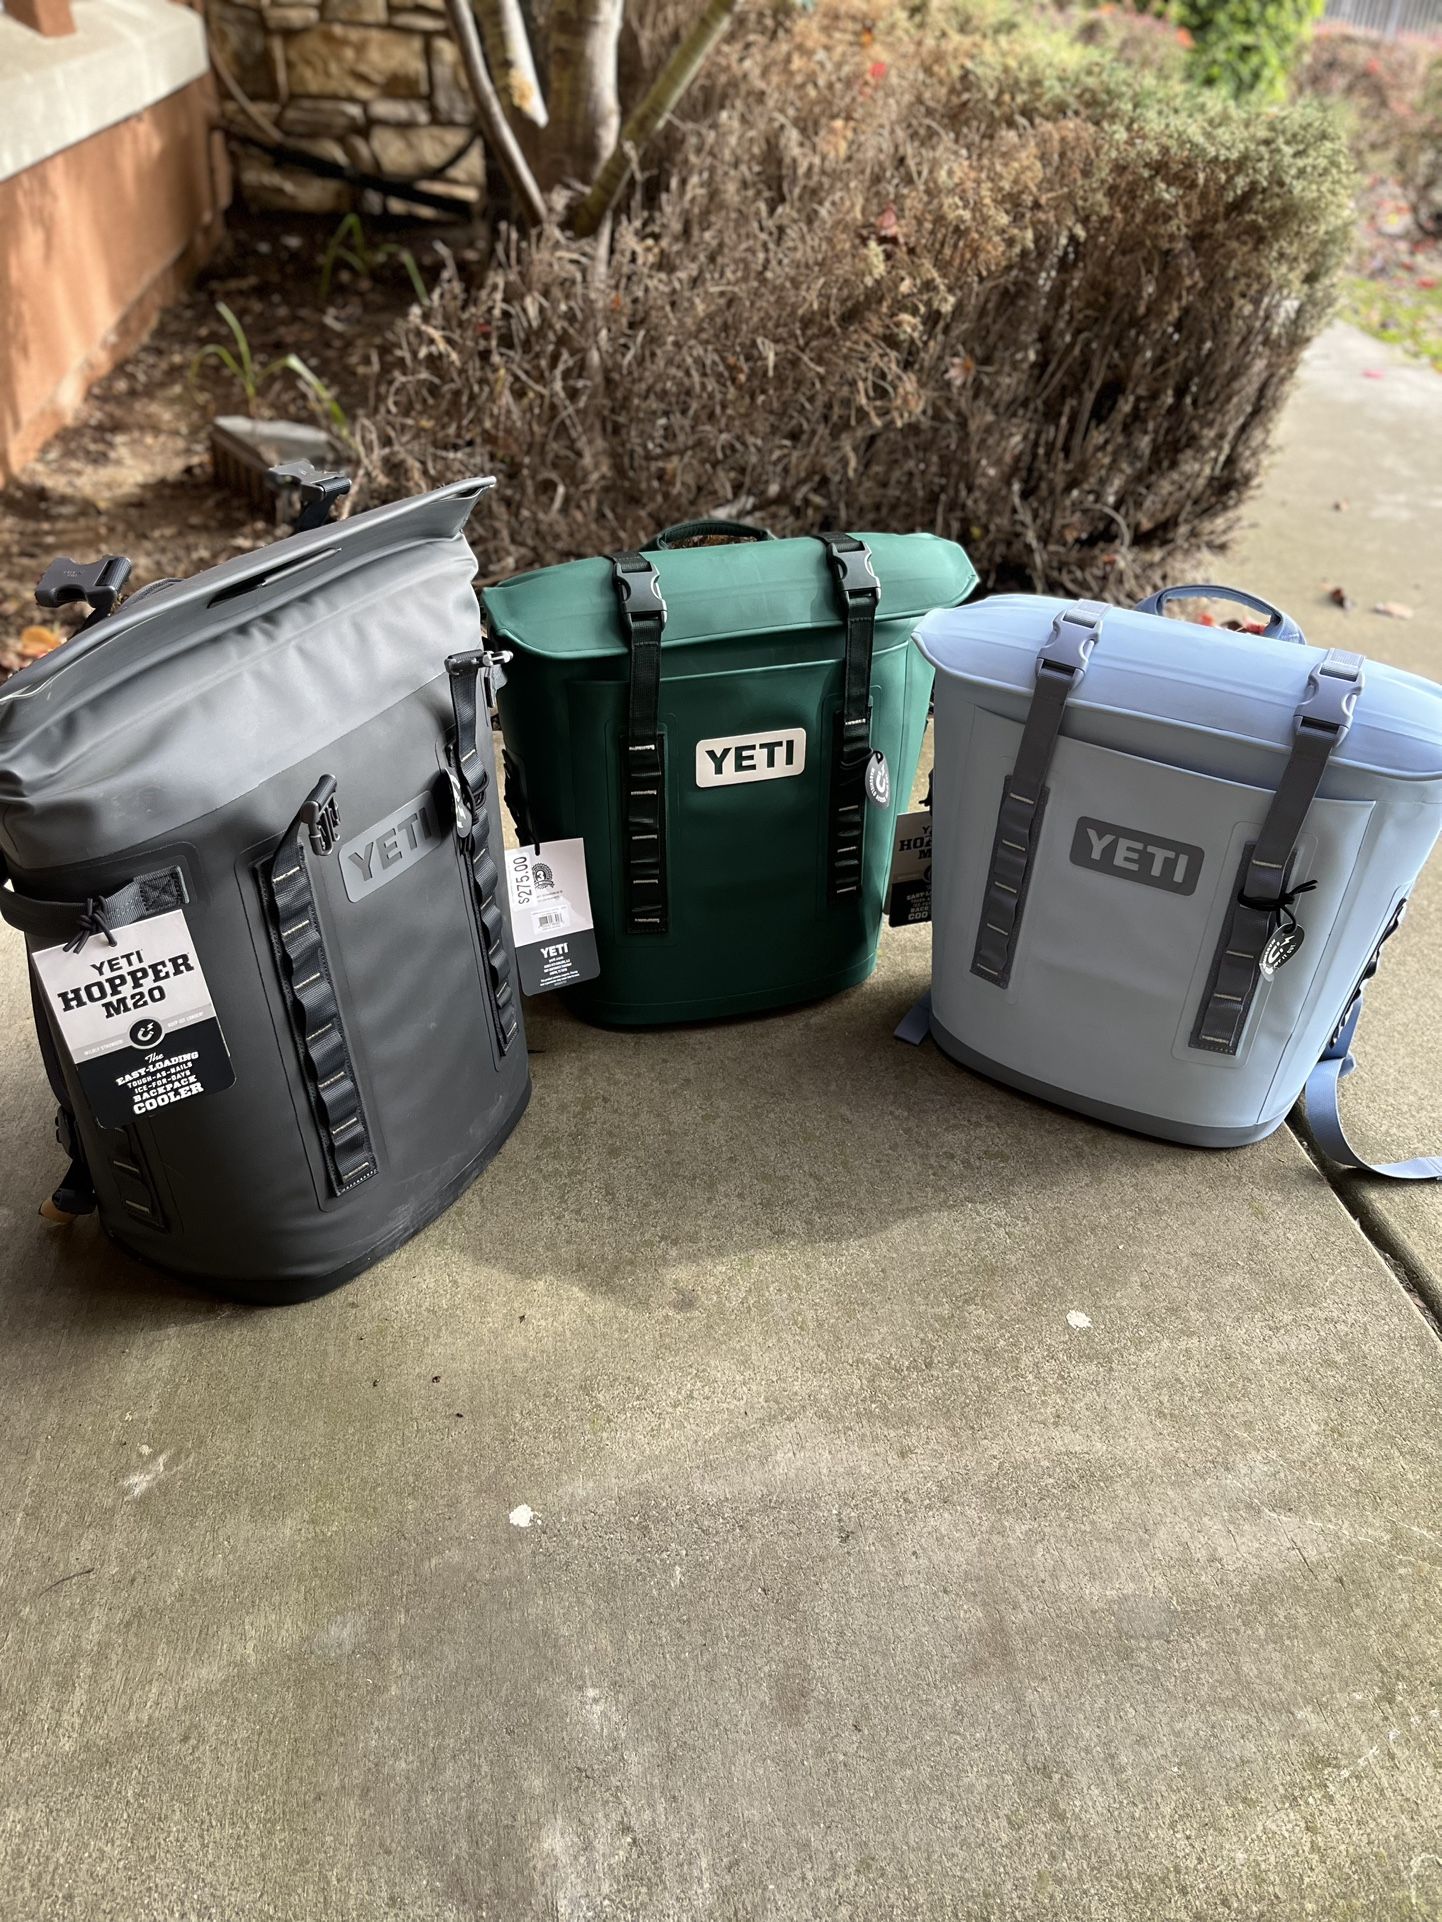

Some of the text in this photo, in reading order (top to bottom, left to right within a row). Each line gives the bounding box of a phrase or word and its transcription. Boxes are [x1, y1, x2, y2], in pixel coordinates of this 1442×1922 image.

[705, 740, 794, 775] YETI
[348, 807, 432, 881] YETI
[1086, 828, 1189, 883] YETI
[513, 856, 533, 905] $275.00
[90, 950, 144, 977] YETI
[540, 942, 569, 958] YETI
[57, 953, 195, 1012] HOPPER
[101, 985, 167, 1019] M20
[115, 1051, 199, 1086] EASY-LOADING
[127, 1061, 193, 1088] TOUGH-AS-NAILS
[145, 1052, 164, 1064] The
[132, 1075, 197, 1102] BACKPACK
[133, 1082, 204, 1114] COOLER
[134, 1070, 191, 1094] ICE-FOR-DAYS
